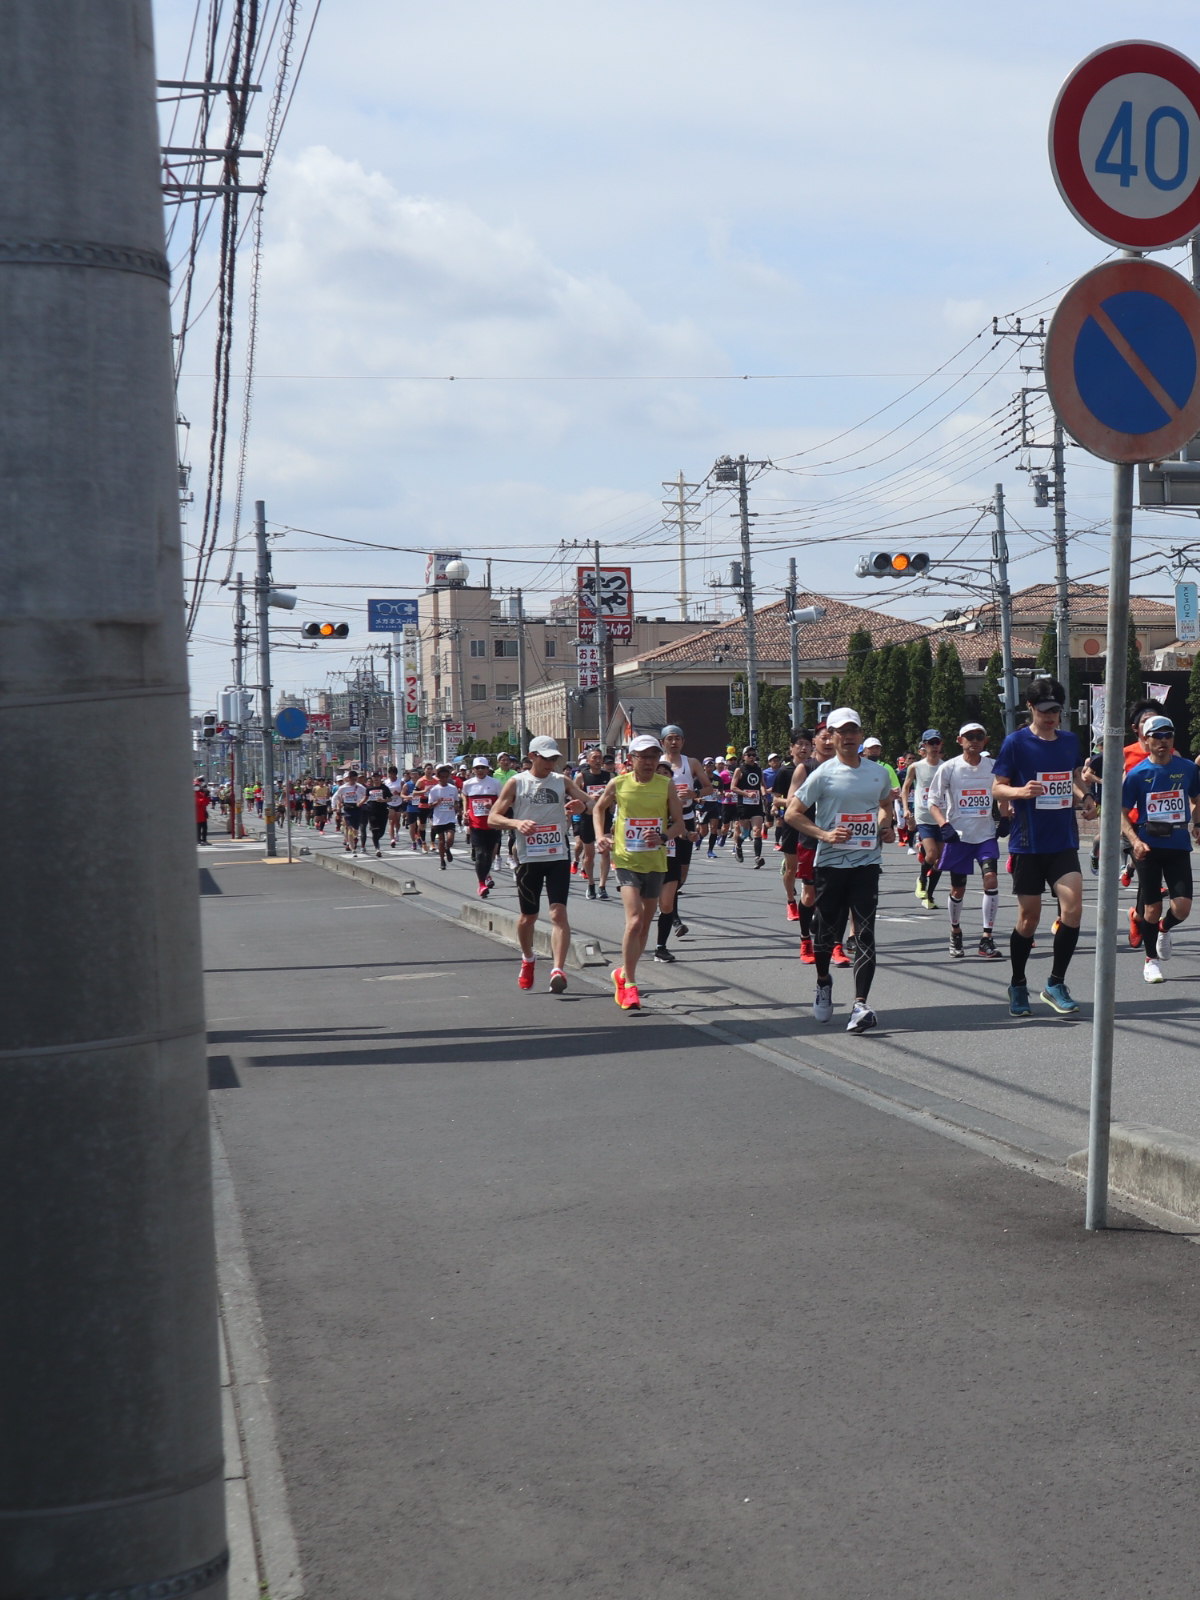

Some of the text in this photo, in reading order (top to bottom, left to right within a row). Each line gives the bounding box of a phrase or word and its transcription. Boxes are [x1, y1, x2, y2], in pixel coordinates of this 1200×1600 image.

[1095, 101, 1189, 191] 40
[405, 676, 417, 713] つくし
[1049, 781, 1072, 795] 6665
[967, 796, 990, 807] 2993
[1157, 798, 1183, 811] 7360
[847, 823, 876, 836] 2984
[536, 832, 560, 844] 6320
